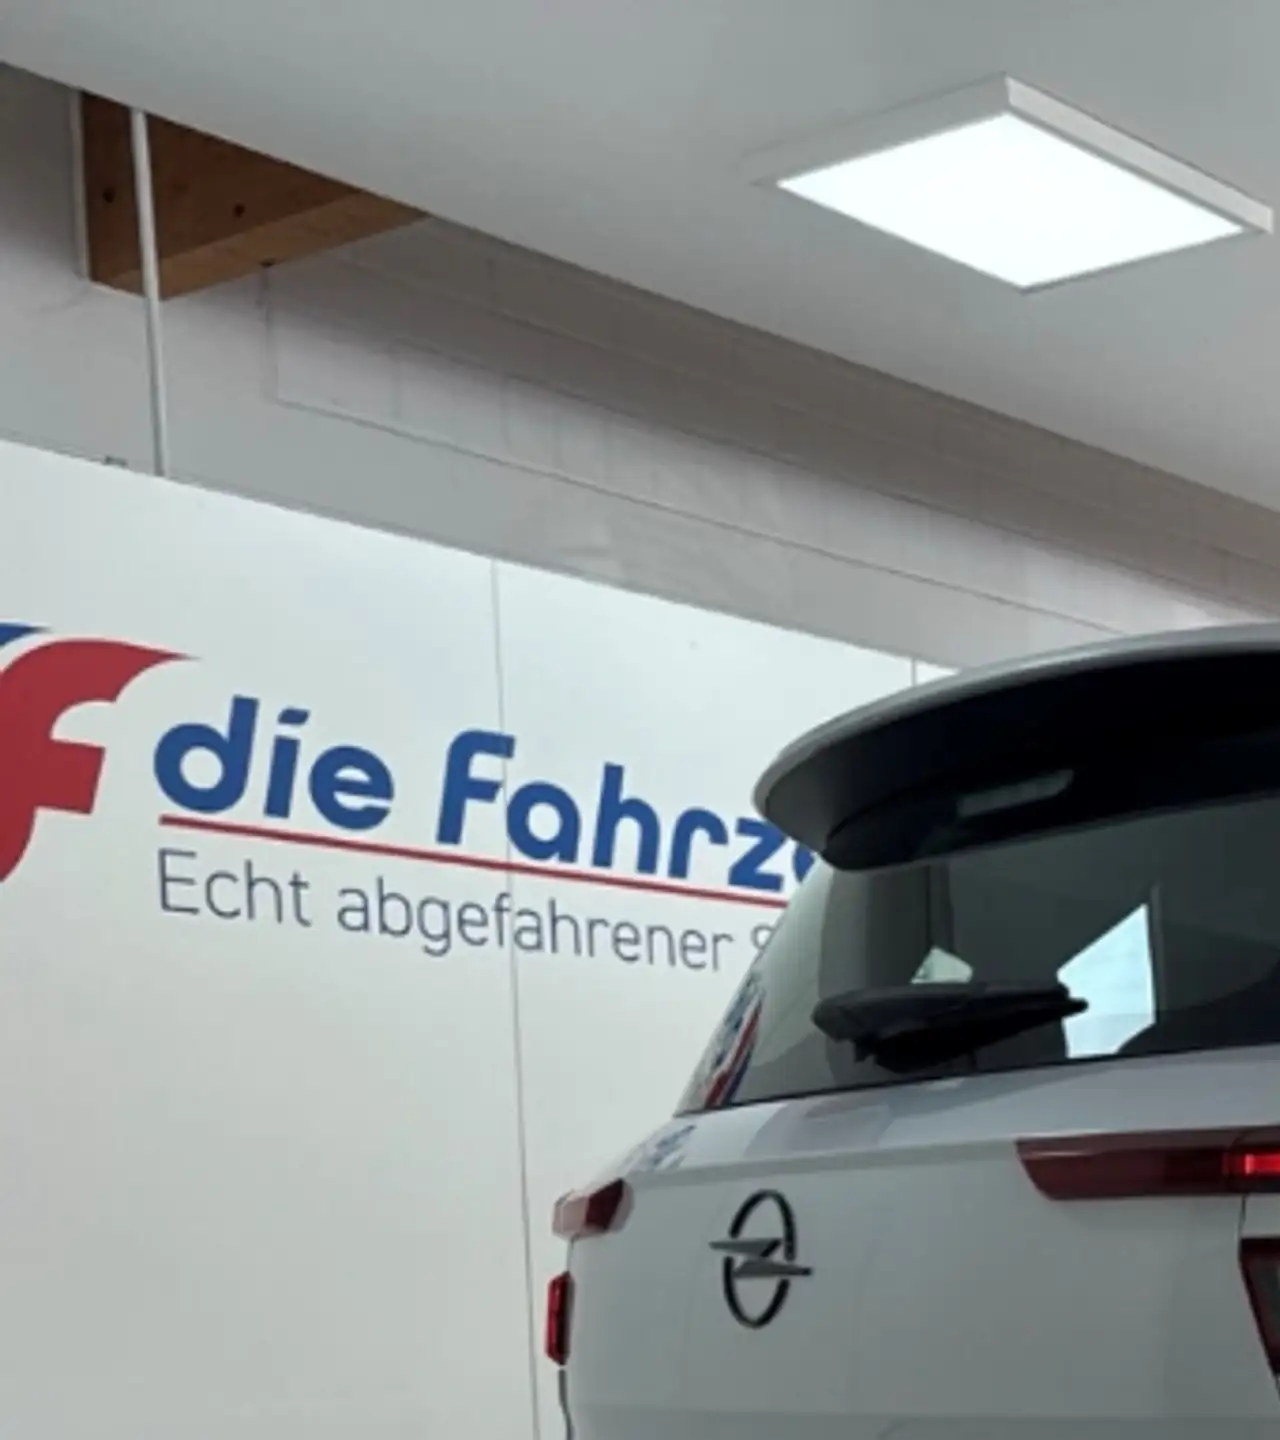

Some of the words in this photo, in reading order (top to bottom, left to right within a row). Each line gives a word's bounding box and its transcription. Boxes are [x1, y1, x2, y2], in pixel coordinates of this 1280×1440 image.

[154, 694, 395, 831] die
[436, 728, 816, 892] Fahrz
[158, 847, 313, 928] Echt
[337, 875, 735, 972] abgefahrener
